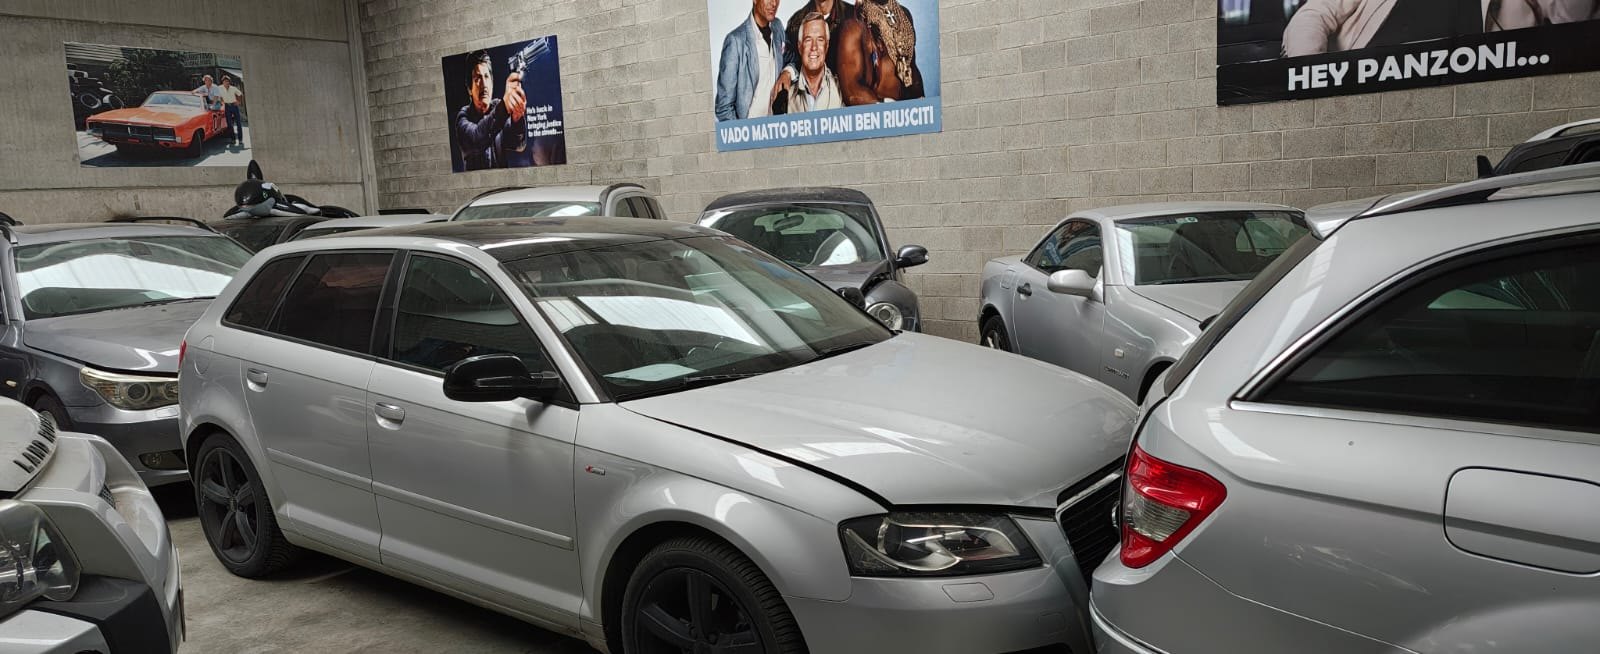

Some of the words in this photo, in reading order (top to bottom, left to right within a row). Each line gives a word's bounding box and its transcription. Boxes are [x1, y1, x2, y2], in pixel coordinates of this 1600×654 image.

[1288, 61, 1349, 91] HEY
[1357, 41, 1550, 84] PANZONI...
[527, 114, 537, 122] New
[537, 113, 547, 121] York
[720, 128, 750, 144] VADO
[752, 123, 788, 142] MATTO
[790, 120, 814, 137] PER
[814, 119, 819, 136] I
[821, 115, 853, 134] PIANI
[855, 111, 881, 131] BEN
[883, 105, 934, 128] RIUSCITI
[13, 440, 50, 474] LAND
